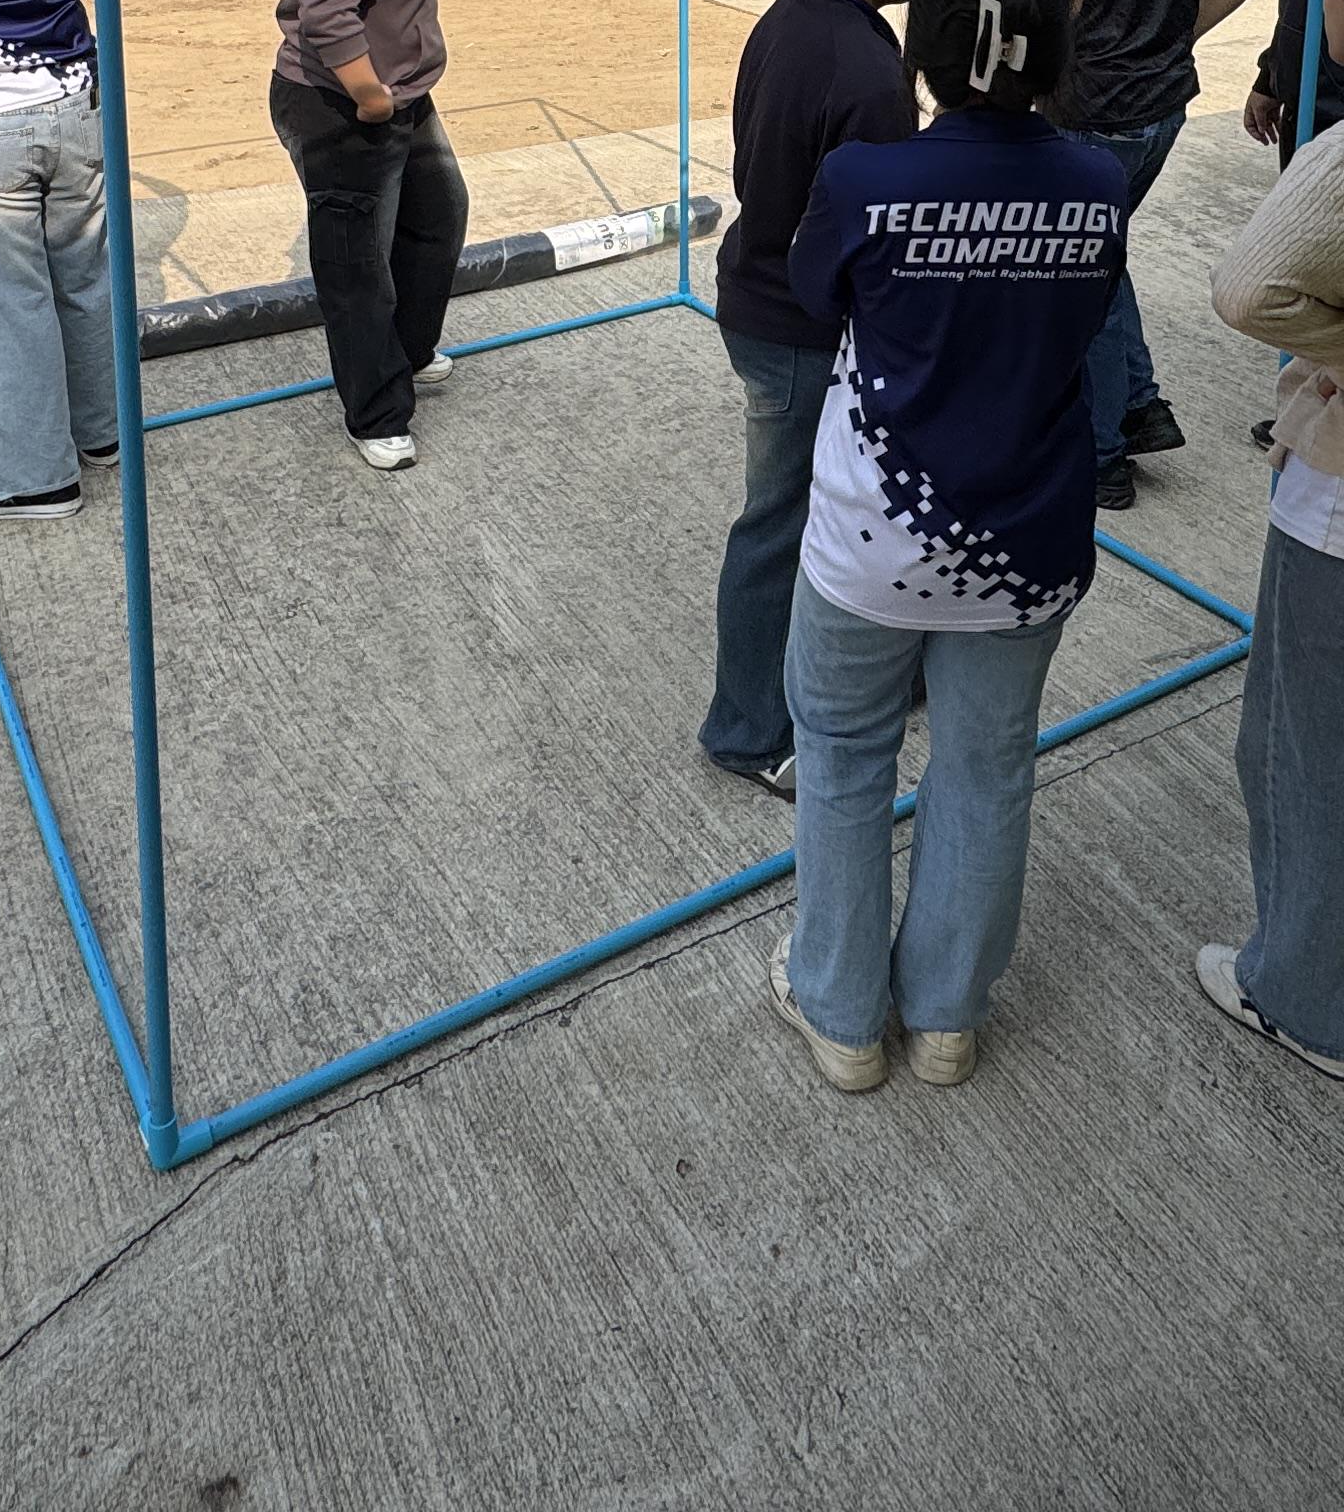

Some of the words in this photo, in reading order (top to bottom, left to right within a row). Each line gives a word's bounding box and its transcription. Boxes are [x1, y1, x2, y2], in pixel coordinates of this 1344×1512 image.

[864, 201, 1121, 236] TECHNOLOGY
[904, 237, 1105, 265] COMPUTER
[890, 267, 964, 283] Kamphaeng
[967, 268, 997, 280] Phet
[1000, 268, 1056, 282] Rajabhat
